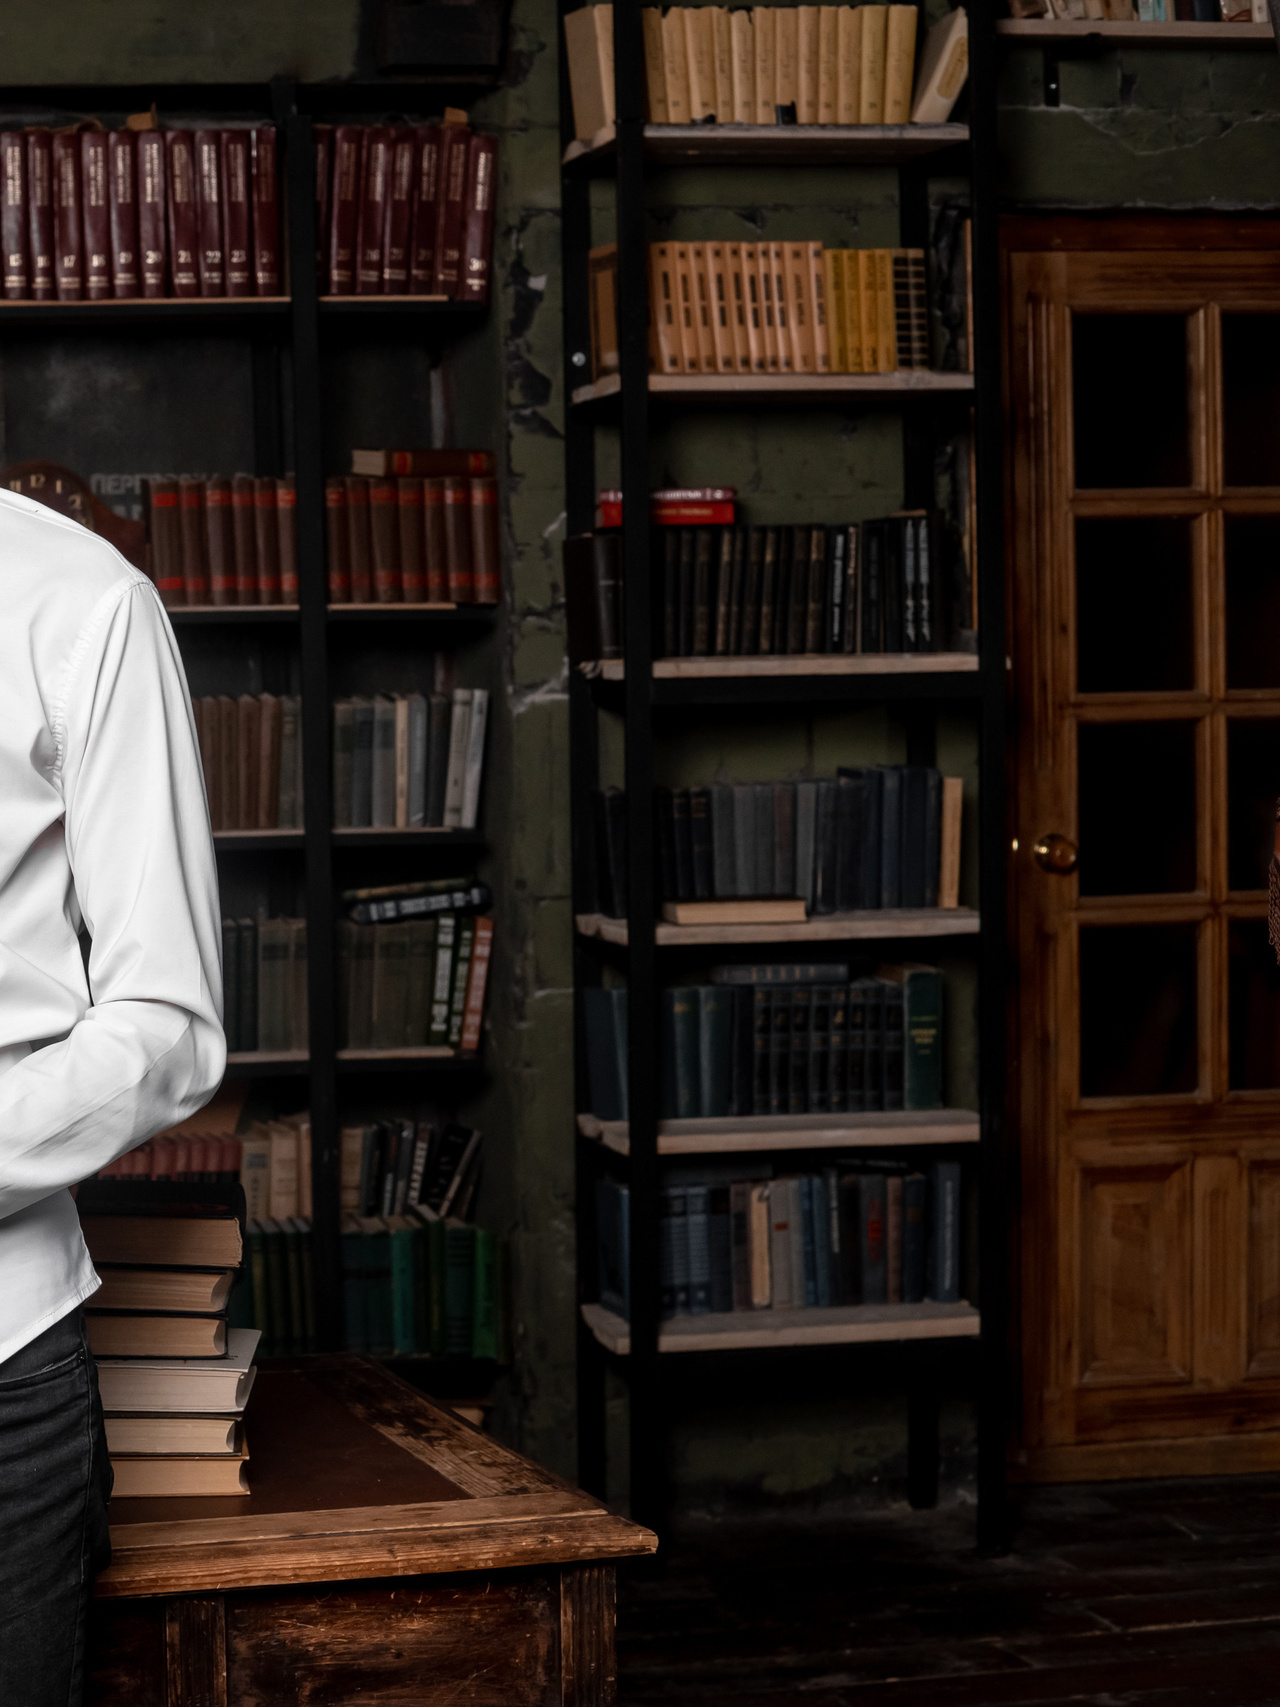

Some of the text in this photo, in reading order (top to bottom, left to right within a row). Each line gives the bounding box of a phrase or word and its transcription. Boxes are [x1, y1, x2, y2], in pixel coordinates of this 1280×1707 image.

[63, 255, 76, 268] 17
[145, 250, 162, 264] 20
[177, 250, 192, 264] 21
[206, 250, 221, 264] 22
[230, 250, 246, 264] 23
[469, 257, 486, 271] 30
